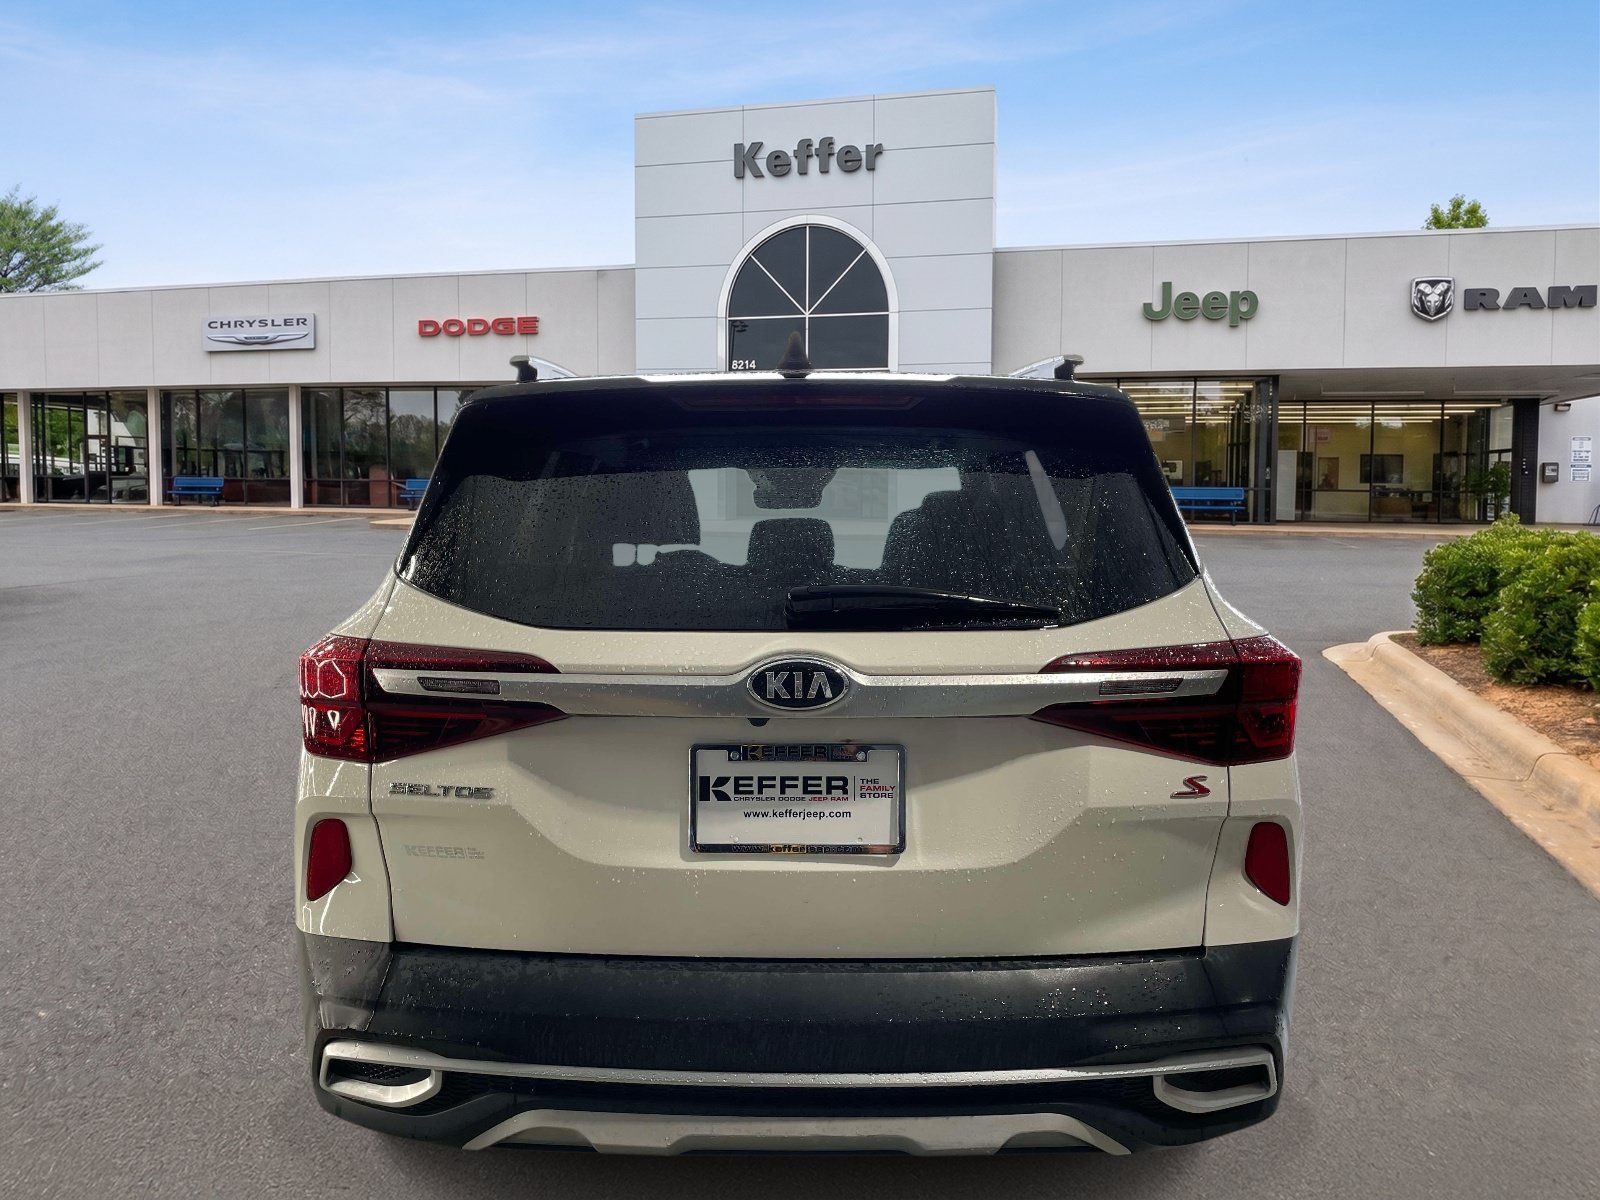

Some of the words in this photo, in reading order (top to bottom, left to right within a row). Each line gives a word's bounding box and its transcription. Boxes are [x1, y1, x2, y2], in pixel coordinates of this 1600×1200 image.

[733, 136, 883, 179] Keffer
[1142, 281, 1259, 327] Jeep
[1463, 284, 1598, 311] RAM
[207, 317, 308, 329] CHRYSLER
[418, 315, 539, 337] DODGE
[731, 359, 756, 370] 8214
[765, 671, 833, 699] KIA
[741, 744, 828, 760] KEFFER
[389, 782, 495, 800] SELTOS
[699, 775, 849, 802] KEFFER
[1170, 775, 1211, 799] S
[743, 808, 852, 821] www.kefferjeep.com
[731, 844, 863, 854] www.kefferjeep.com
